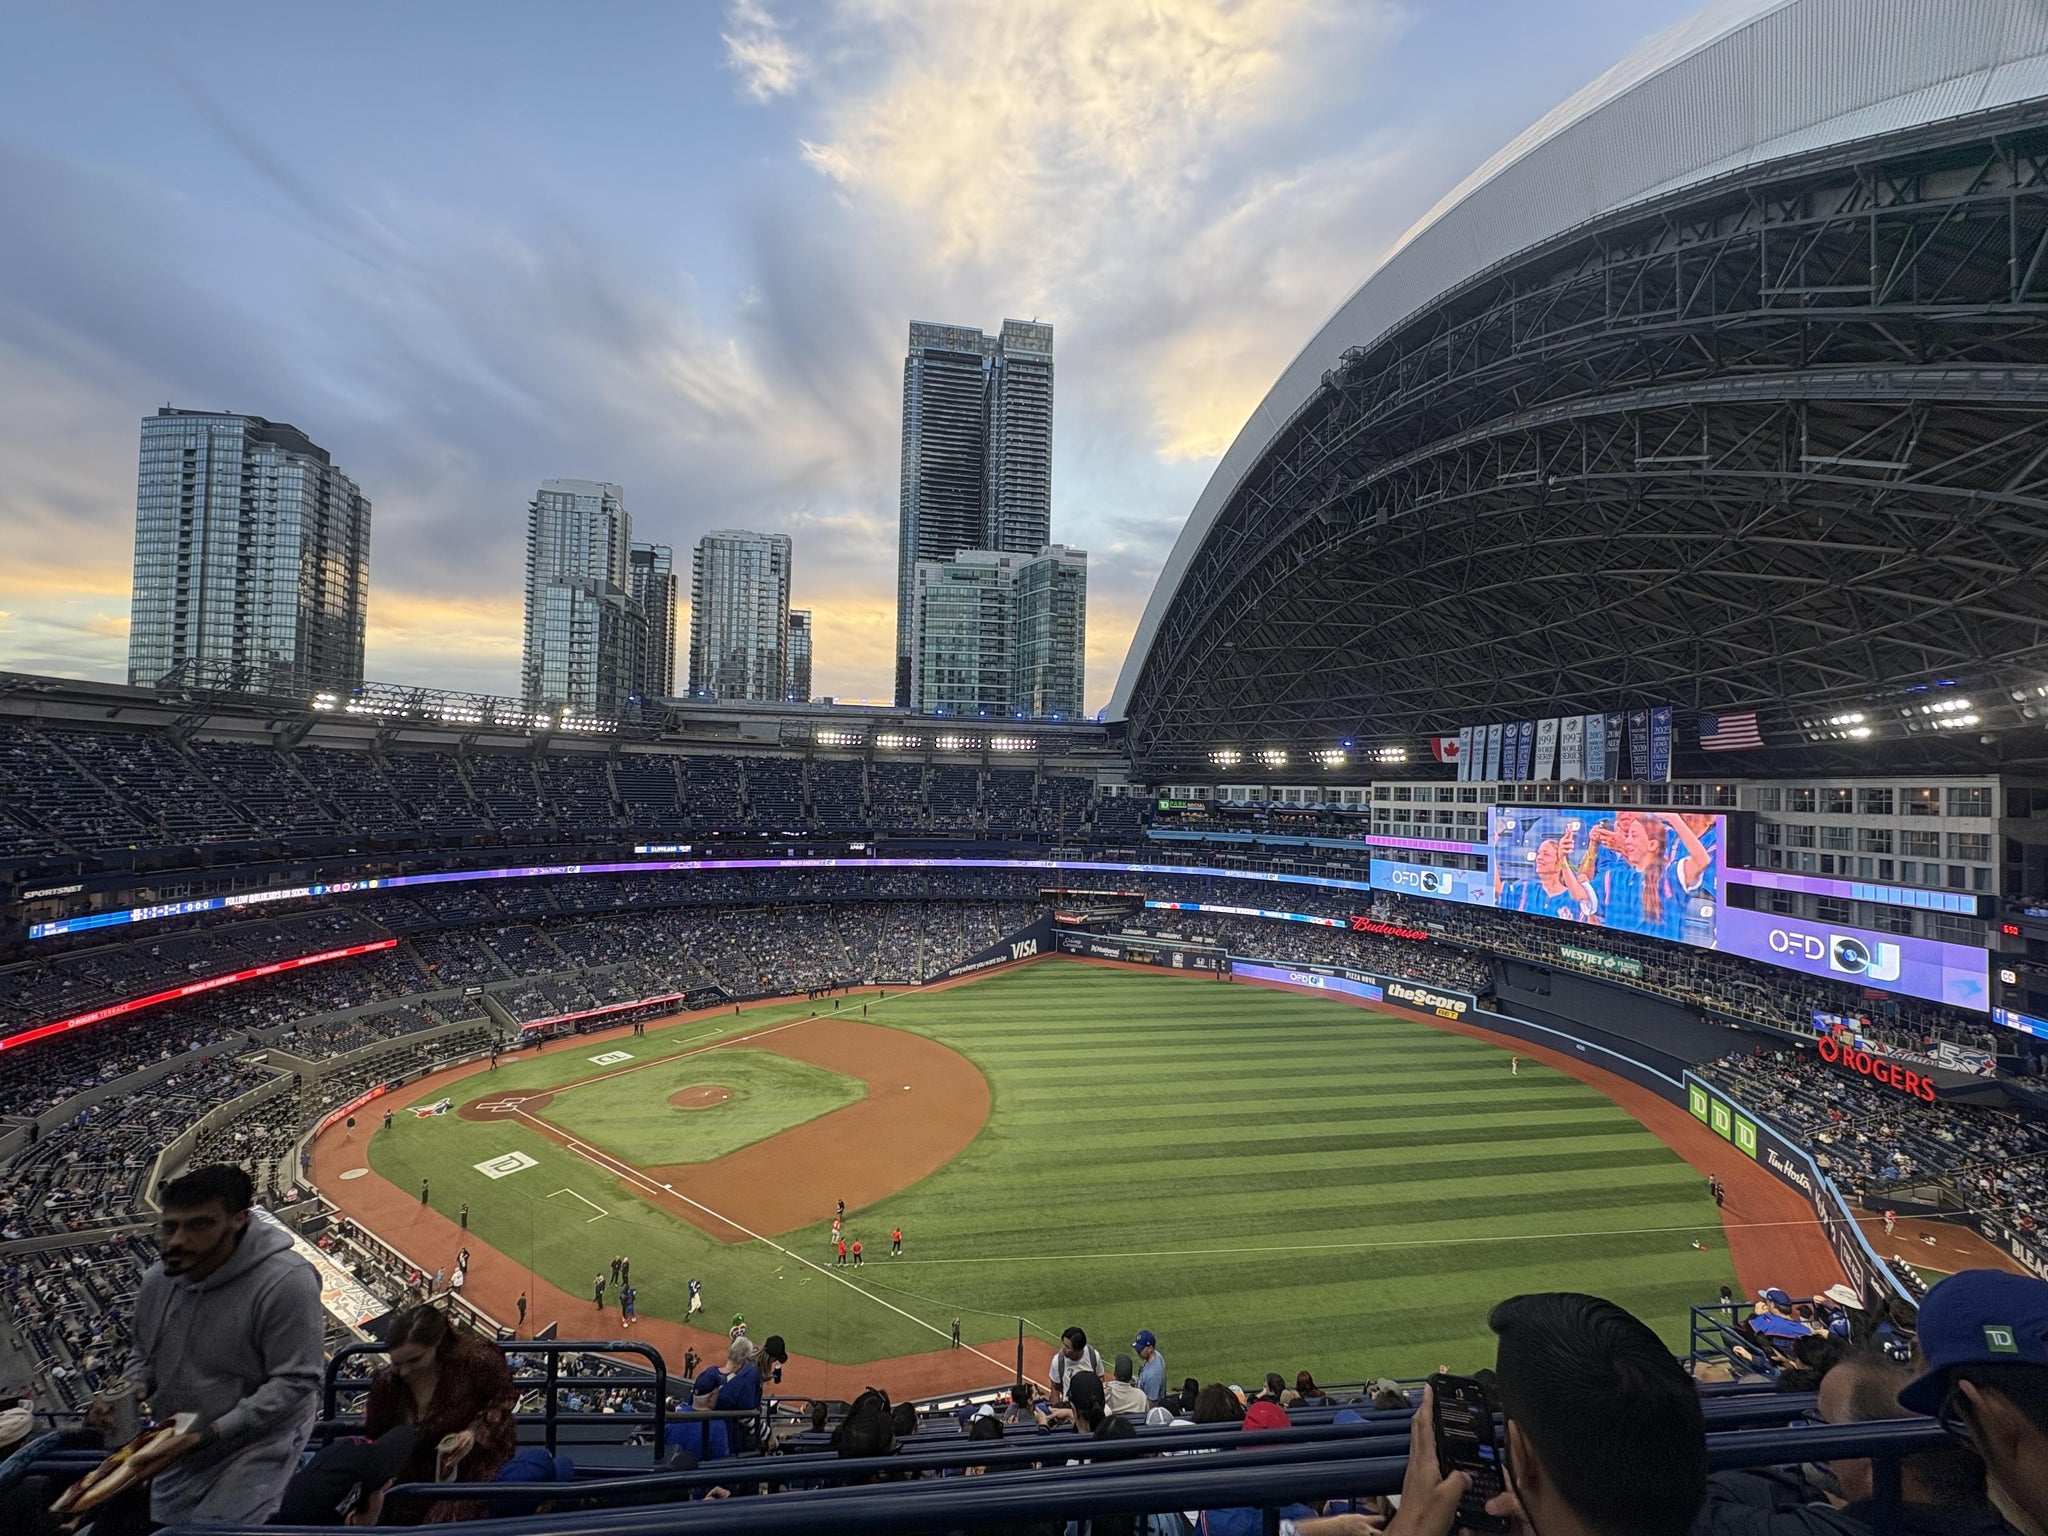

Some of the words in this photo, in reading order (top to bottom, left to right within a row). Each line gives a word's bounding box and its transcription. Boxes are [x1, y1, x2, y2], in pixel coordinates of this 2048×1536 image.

[1632, 733, 1646, 741] 2016
[1654, 726, 1671, 735] 2025
[1562, 752, 1582, 760] SERIES
[1632, 744, 1647, 752] 2020
[1392, 870, 1419, 886] OFD
[23, 884, 84, 899] SPORTSNET
[225, 895, 248, 906] FOLLOW
[291, 887, 310, 897] SOCIAL
[1156, 932, 1182, 940] SUBWAY
[1351, 915, 1428, 940] Budweiser
[1010, 939, 1037, 960] VISA
[1769, 929, 1825, 960] OFD
[1561, 947, 1604, 965] WESTJET
[948, 963, 977, 976] everywhere
[1290, 972, 1308, 983] OFD
[1346, 971, 1360, 981] PIZZA
[1361, 975, 1376, 985] NOVA
[1388, 983, 1467, 1013] theScore
[1842, 1044, 1936, 1102] ROGERS
[1691, 1090, 1705, 1115] TD
[1713, 1105, 1728, 1131] TD
[1736, 1121, 1754, 1149] TD
[1767, 1148, 1783, 1172] Tim
[1985, 1330, 2012, 1346] TD
